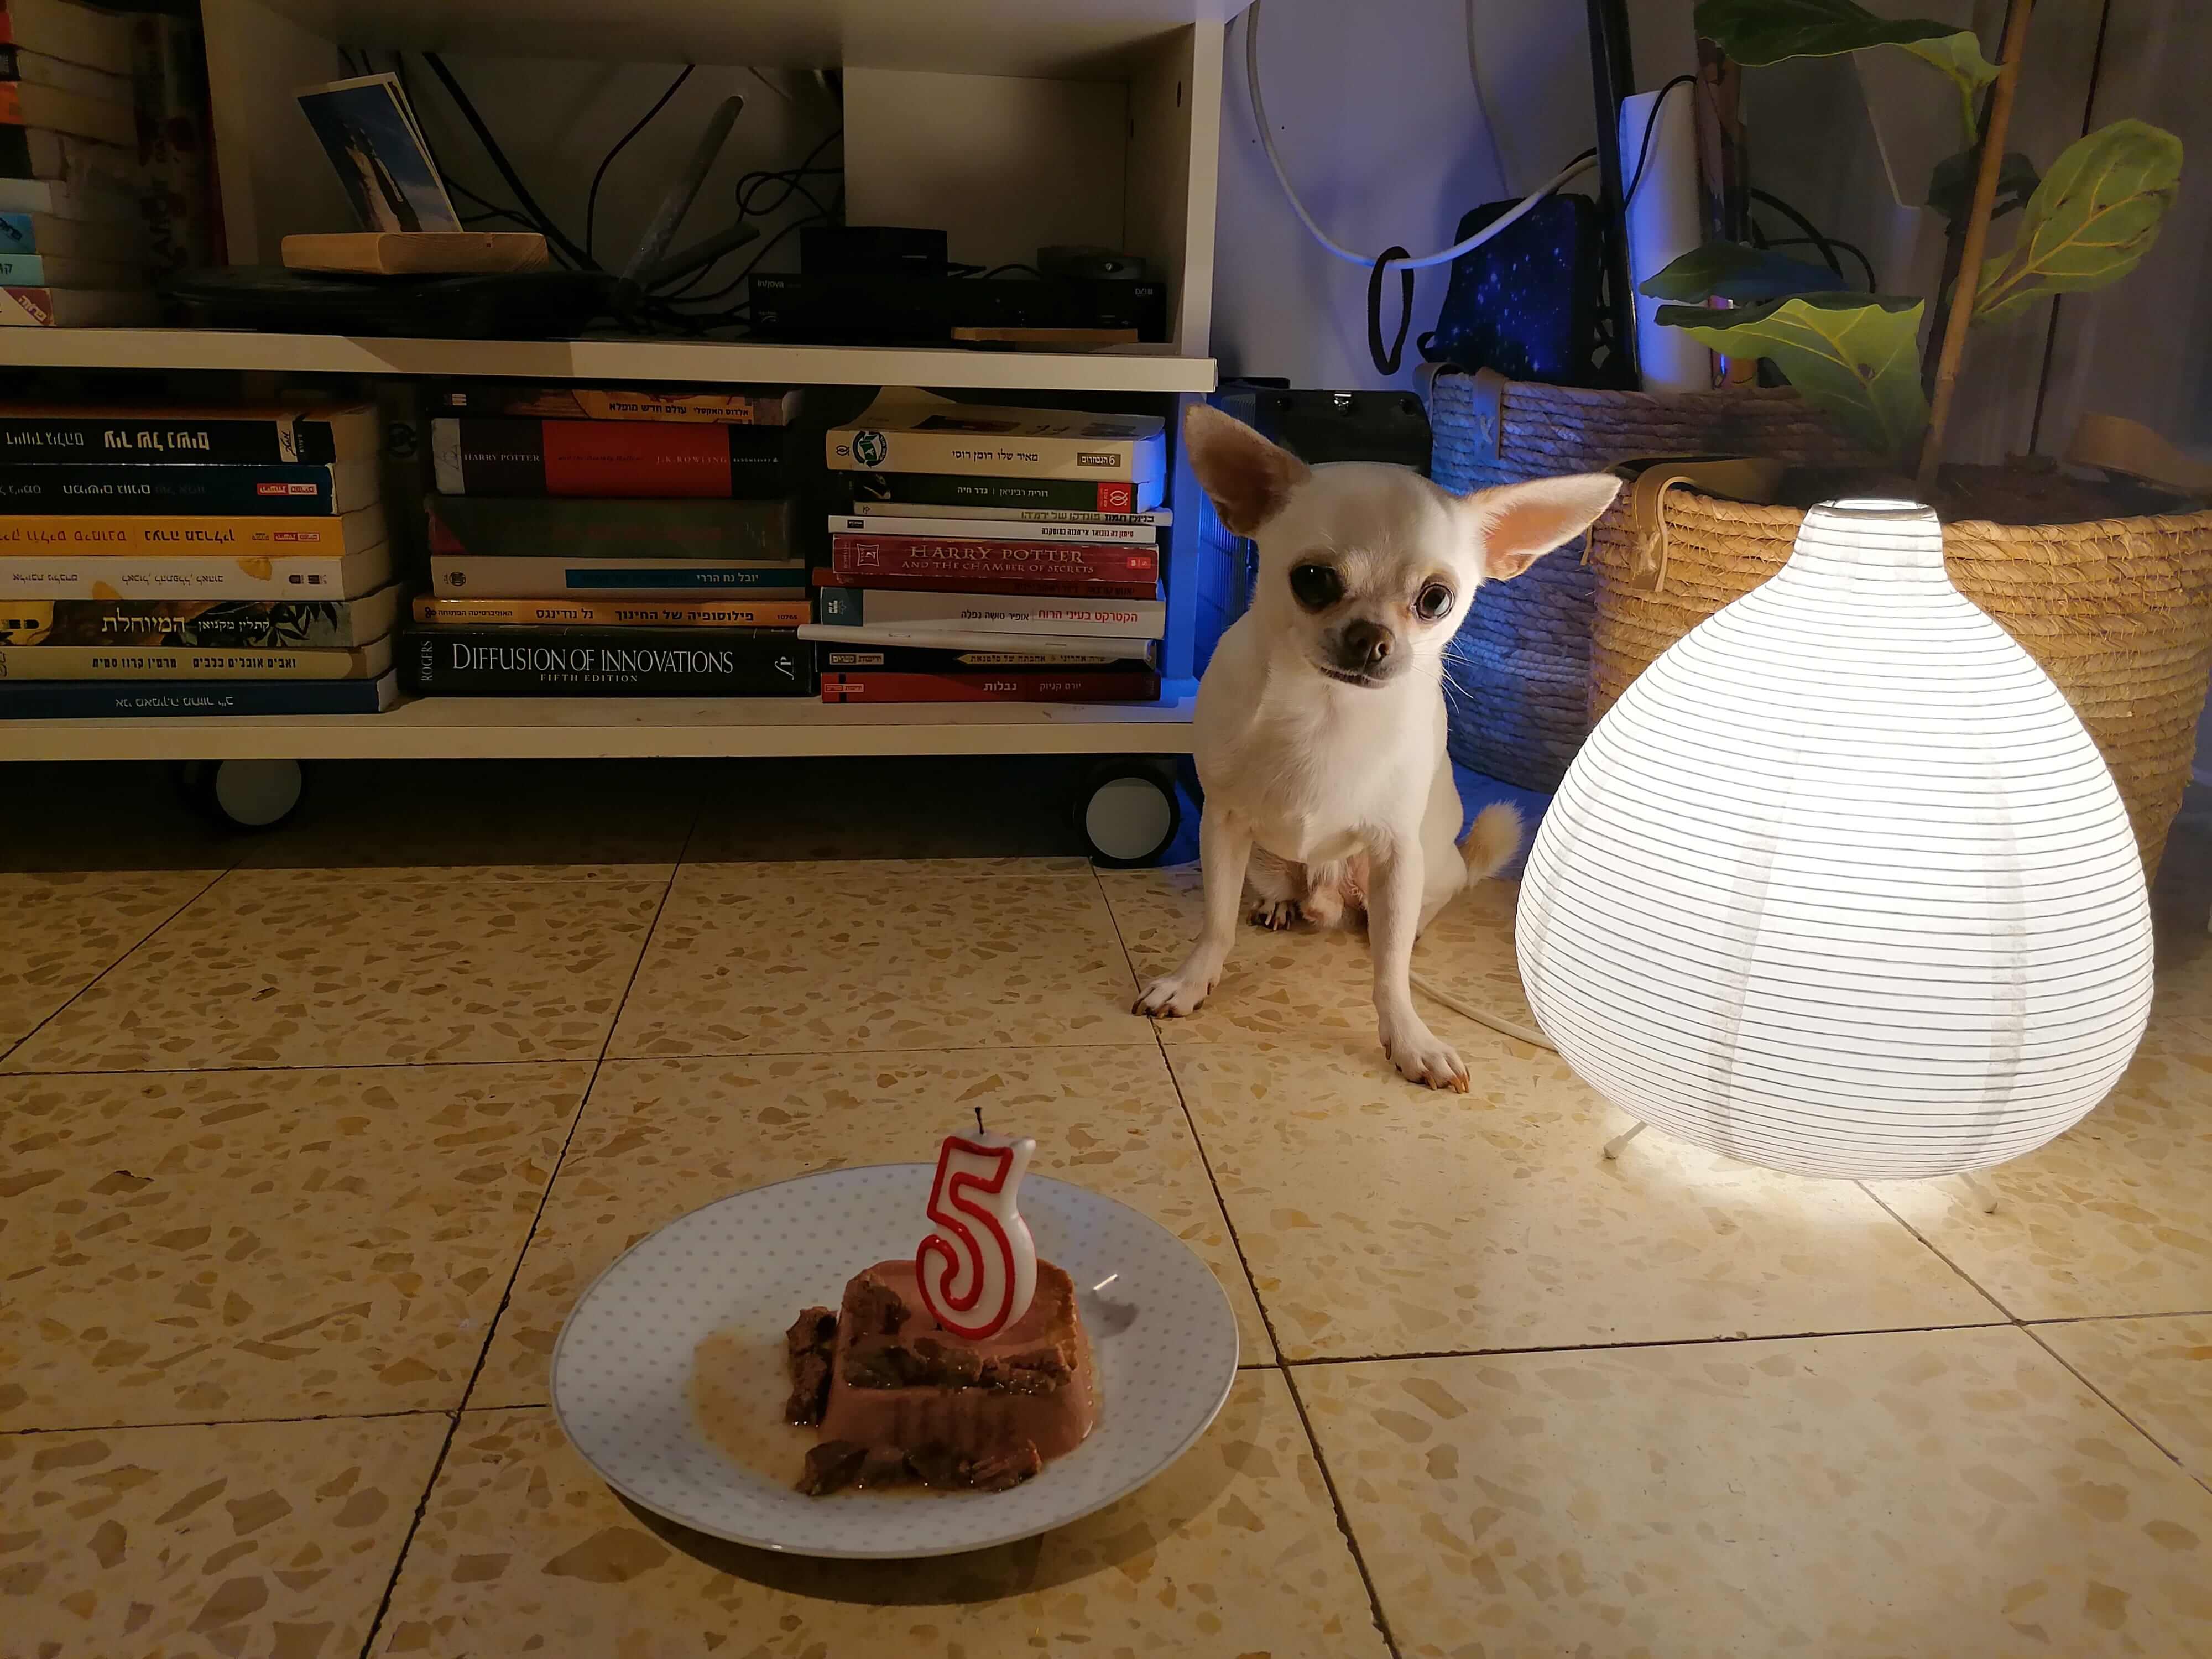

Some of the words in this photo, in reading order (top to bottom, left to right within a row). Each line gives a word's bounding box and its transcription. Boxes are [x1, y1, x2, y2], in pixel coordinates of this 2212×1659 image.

[609, 403, 638, 412] מופלא
[641, 404, 662, 413] חדש
[665, 404, 687, 414] עולם
[693, 406, 723, 416] האקסלי
[726, 408, 749, 416] אלדוס
[45, 432, 84, 447] גילהם
[103, 431, 133, 448] עיר
[137, 431, 164, 451] של
[168, 432, 210, 450] נשים
[500, 453, 540, 462] POTTER
[953, 451, 971, 460] רוסי
[974, 451, 993, 462] רומן
[998, 449, 1014, 461] שלו
[1017, 452, 1039, 462] מאיר
[63, 484, 113, 495] חמישים
[116, 484, 150, 495] גוונים
[957, 486, 972, 494] חיה
[974, 487, 988, 495] גדר
[999, 488, 1027, 497] רביניאן
[1029, 489, 1049, 498] דורית
[1051, 511, 1067, 520] של
[74, 530, 128, 541] סימונס
[145, 530, 179, 541] נערה
[185, 529, 235, 544] מברלין
[911, 544, 994, 561] HARRY
[1001, 548, 1084, 564] POTTER
[902, 561, 929, 569] AND
[933, 561, 960, 571] THE
[963, 562, 1025, 572] CHAMBER
[1048, 565, 1094, 573] SECRETS
[13, 573, 44, 584] אליזבת
[48, 574, 78, 584] גילברט
[196, 575, 223, 585] לאהוב
[696, 574, 719, 583] הררי
[723, 575, 735, 583] נח
[738, 572, 761, 583] יובל
[536, 609, 577, 619] נודינגס
[581, 608, 593, 619] נל
[615, 610, 658, 622] החינוך
[664, 608, 682, 620] של
[688, 610, 754, 620] פילוסופיה
[1008, 612, 1029, 621] אופיר
[1038, 608, 1062, 619] הרוח
[1066, 610, 1091, 620] בעיני
[1094, 611, 1138, 624] הקטרקט
[102, 607, 185, 633] המיוחלת
[238, 615, 270, 633] קתלין
[198, 619, 235, 633] מקגואן
[92, 658, 117, 668] סמית
[122, 658, 143, 669] קרוז
[148, 658, 177, 669] מרטין
[193, 657, 224, 669] כלבים
[228, 657, 263, 669] אוכלים
[268, 658, 296, 669] זאבים
[420, 641, 434, 681] ROGERS
[452, 643, 566, 671] DIFFUSION
[570, 648, 595, 671] OF
[602, 649, 733, 674] INNOVATIONS
[540, 674, 578, 682] FIFTH
[982, 681, 1018, 691] נבלות
[1039, 681, 1062, 692] קניוק
[1064, 681, 1082, 691] יורם
[115, 697, 132, 708] אני
[184, 696, 214, 707] מחזור
[916, 1135, 1015, 1341] 5
